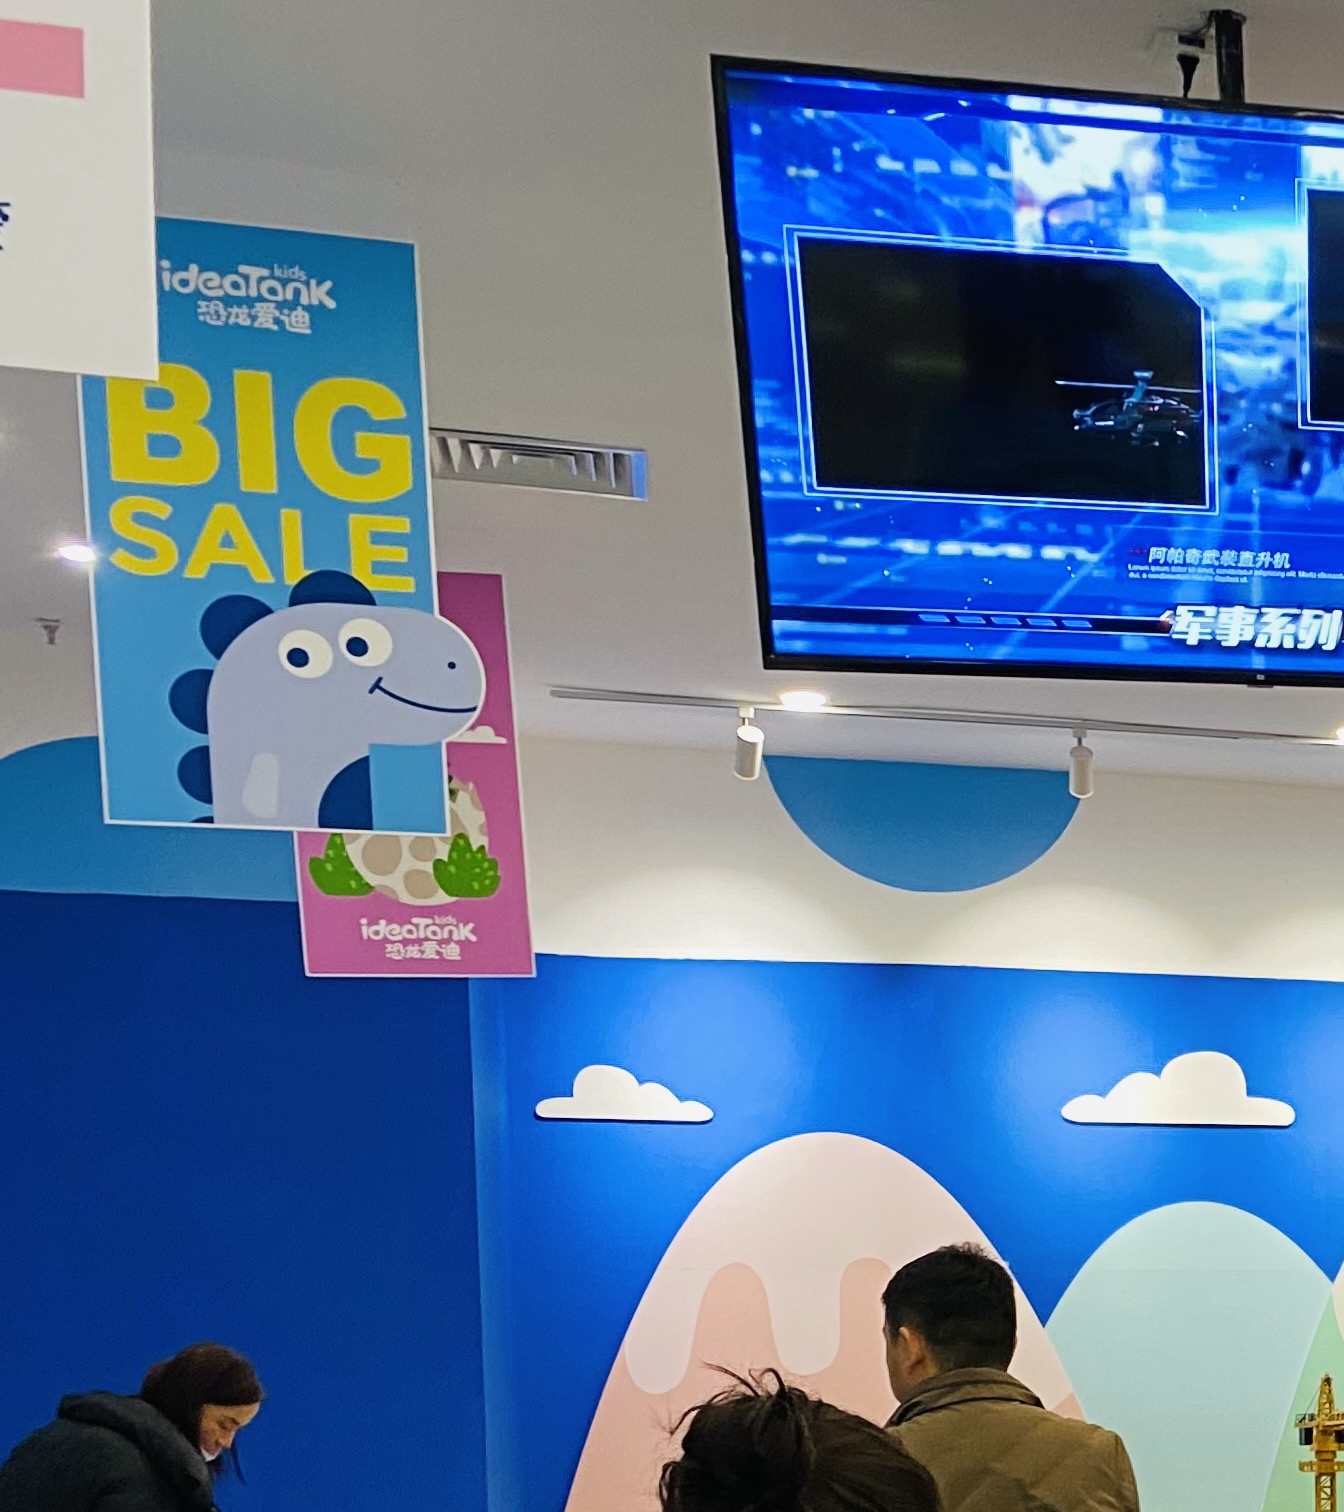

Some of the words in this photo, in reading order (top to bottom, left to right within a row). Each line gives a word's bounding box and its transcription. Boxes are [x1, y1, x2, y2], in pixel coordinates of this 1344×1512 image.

[273, 264, 307, 281] kids
[197, 300, 312, 334] 恐龙爱迪
[105, 361, 413, 502] BIG
[108, 499, 416, 593] SALE
[1149, 546, 1291, 569] 阿帕奇武装直升机
[1171, 604, 1343, 651] 军事系列
